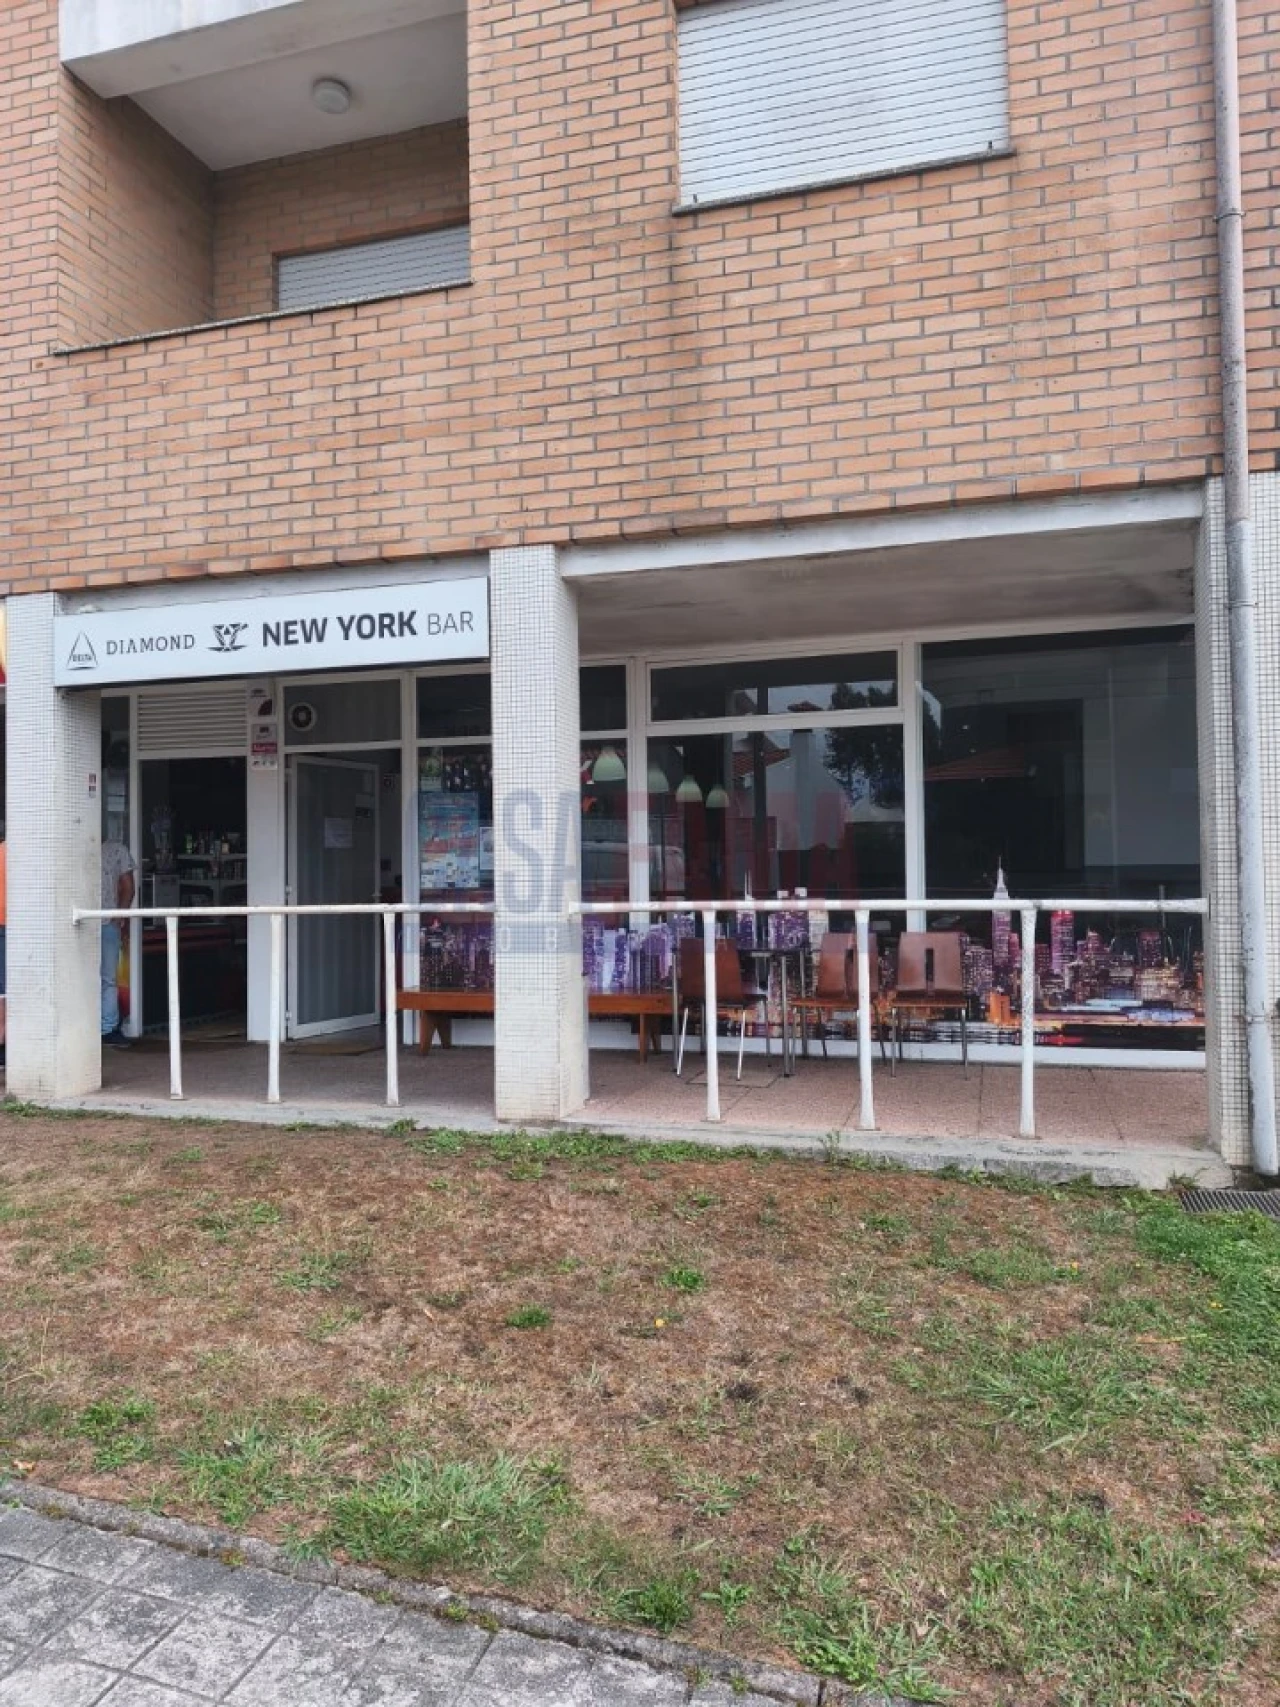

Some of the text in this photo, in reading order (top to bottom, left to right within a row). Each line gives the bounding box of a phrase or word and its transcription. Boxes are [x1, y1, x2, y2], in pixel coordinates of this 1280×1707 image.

[106, 610, 475, 656] DIAMOND NEW YORK BAR
